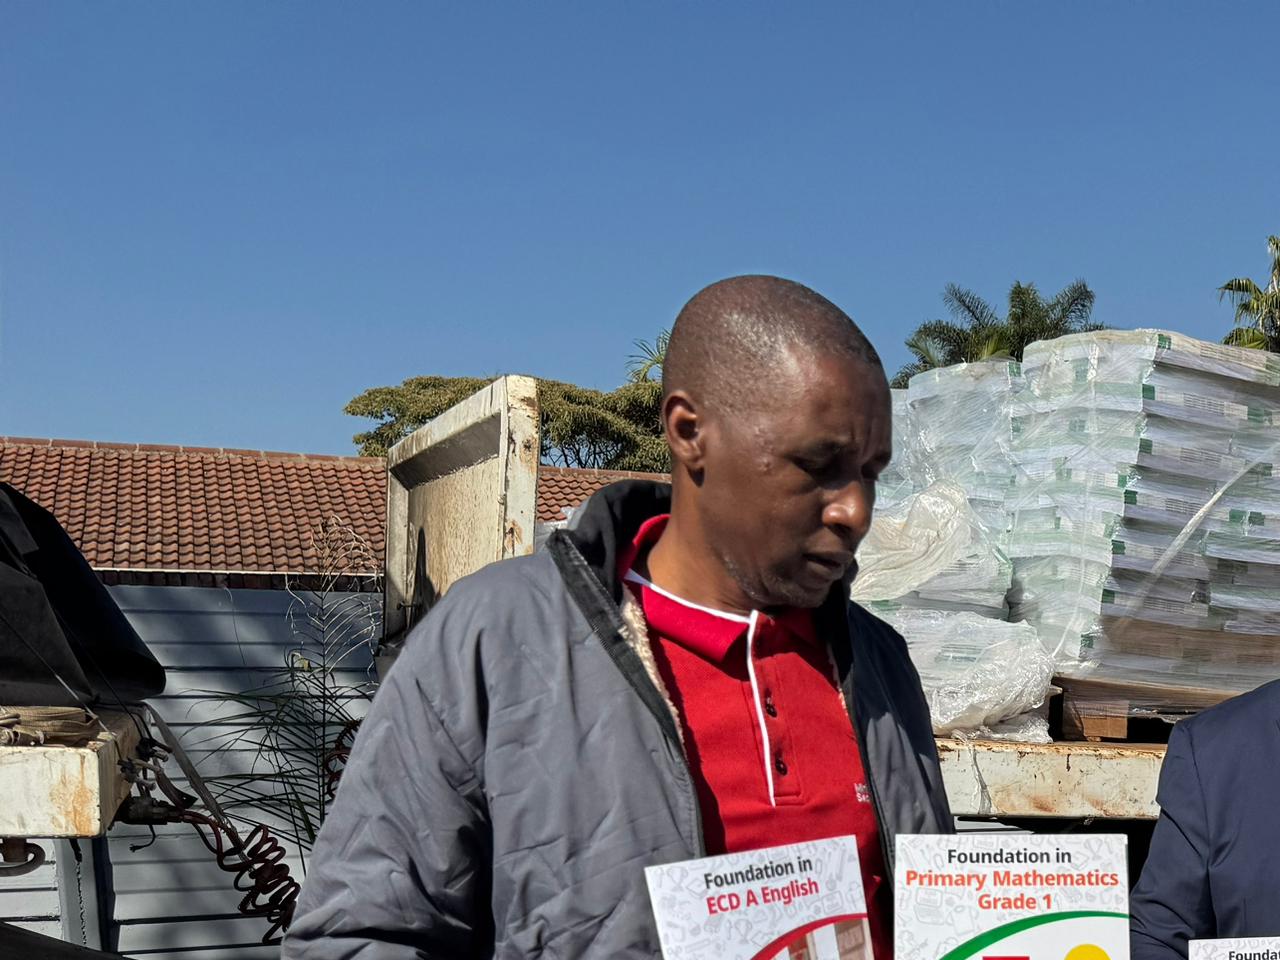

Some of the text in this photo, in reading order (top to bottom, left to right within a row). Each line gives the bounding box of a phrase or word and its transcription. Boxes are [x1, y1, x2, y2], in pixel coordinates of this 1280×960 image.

[948, 848, 1072, 864] Foundation in
[704, 857, 813, 889] Foundation in
[906, 869, 1119, 891] Primary Mathematics
[706, 878, 820, 915] ECD A English
[978, 893, 1053, 910] Grade 1
